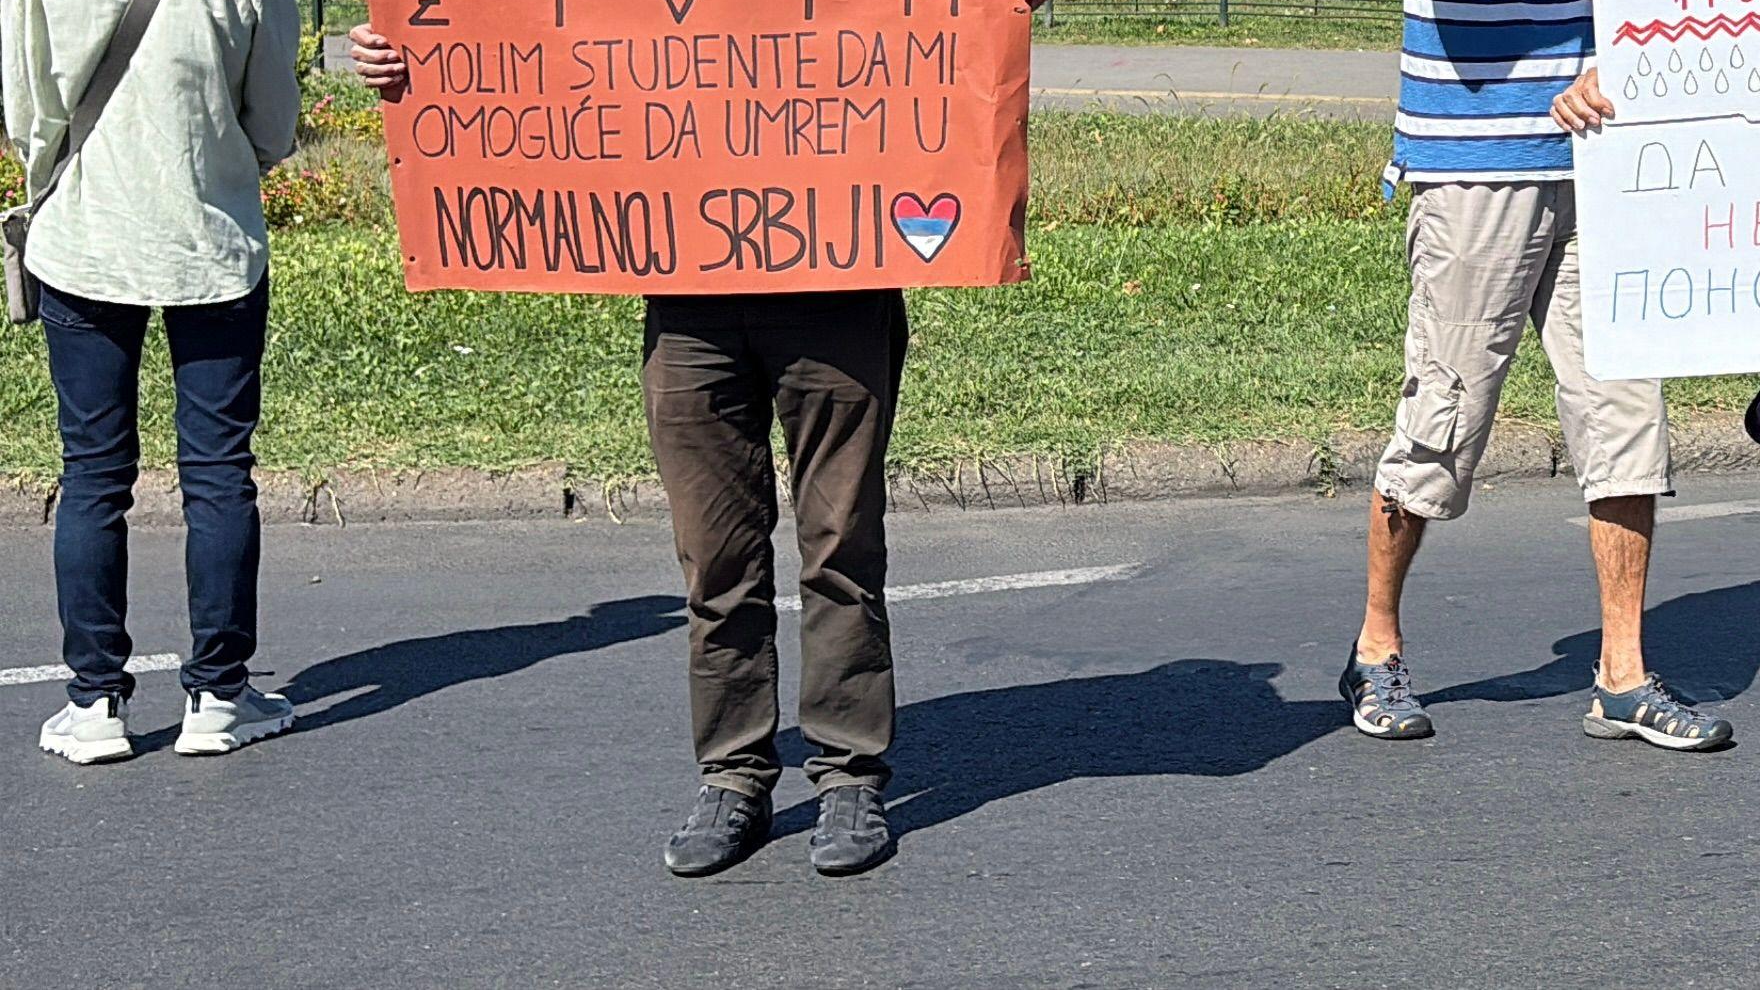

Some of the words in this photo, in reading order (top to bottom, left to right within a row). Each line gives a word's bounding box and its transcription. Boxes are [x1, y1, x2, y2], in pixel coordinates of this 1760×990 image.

[400, 41, 545, 95] MOLIM
[569, 30, 818, 92] STUDENTE
[412, 96, 622, 160] OMOGUĆE
[645, 99, 701, 161] DA
[725, 96, 887, 157] UMREM
[913, 96, 947, 154] U
[1622, 138, 1727, 194] ДА
[432, 184, 678, 276] NORMALNOJ
[699, 183, 886, 272] SRBIJI
